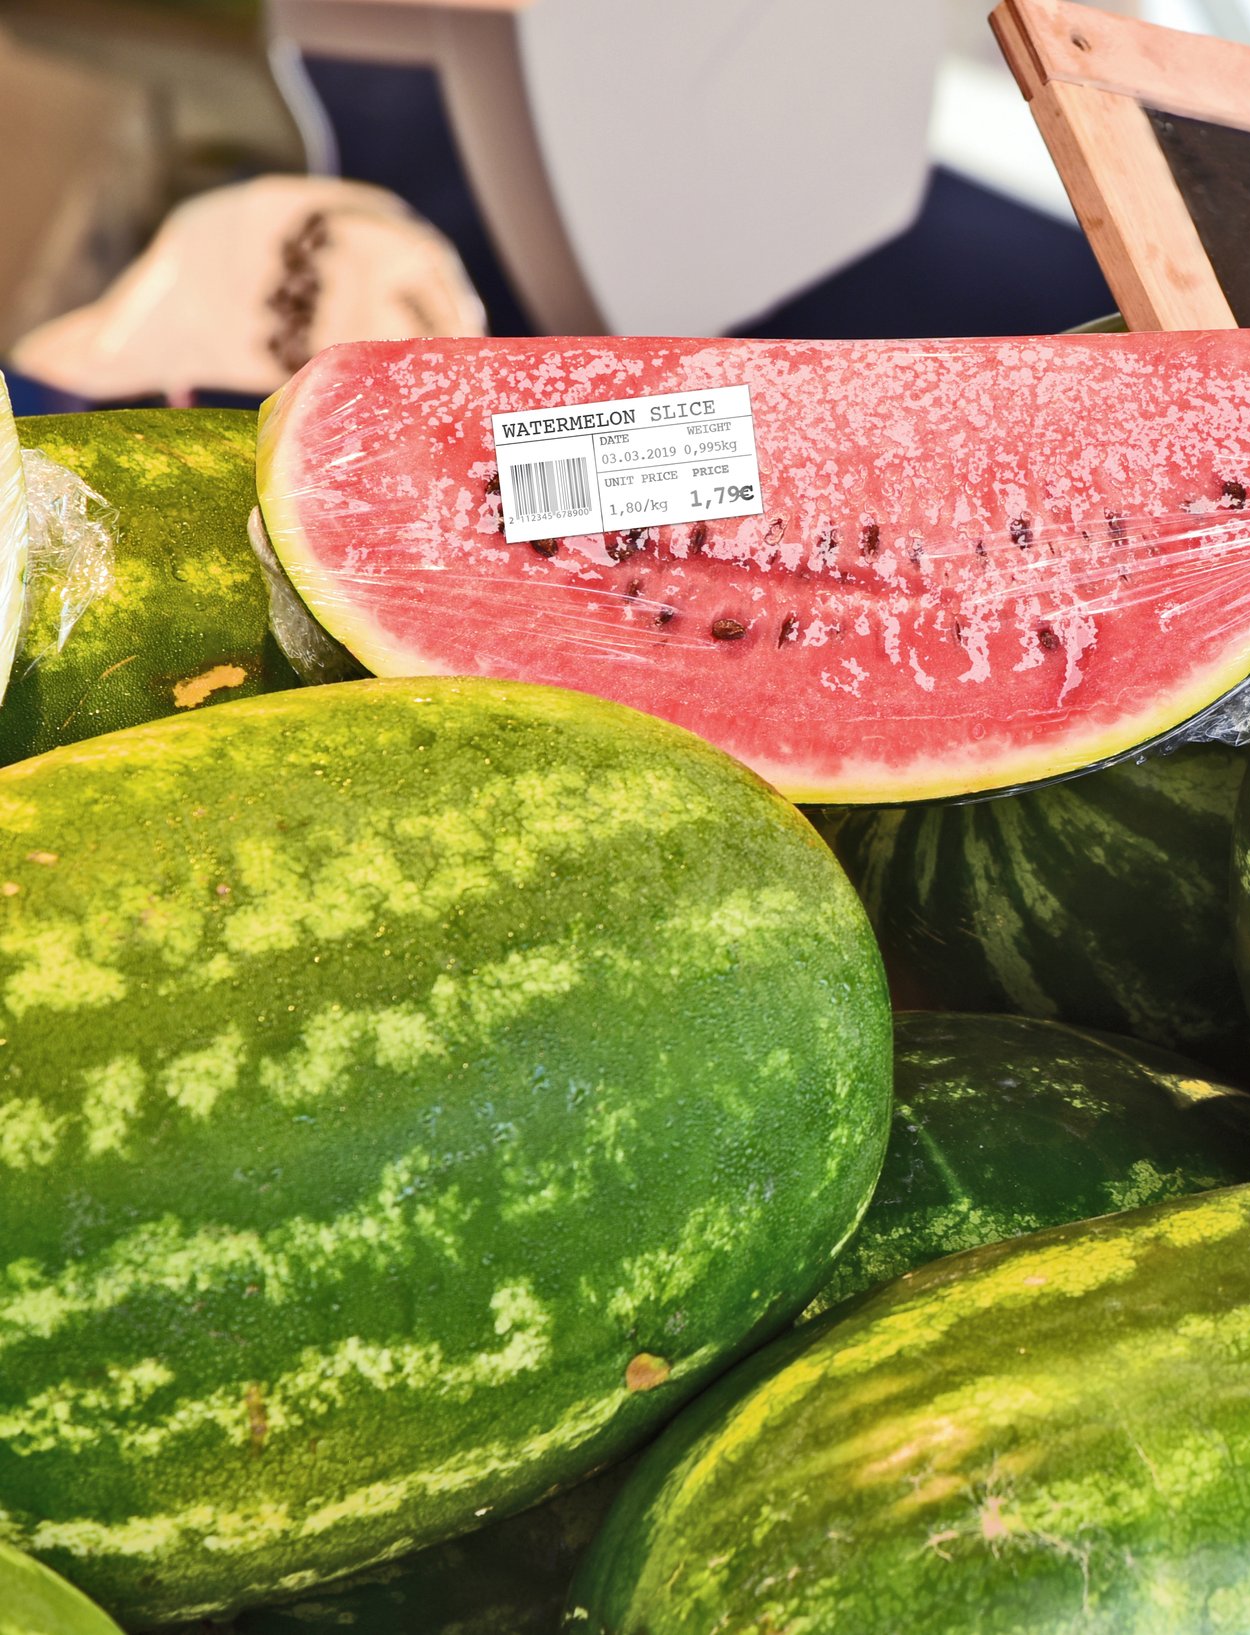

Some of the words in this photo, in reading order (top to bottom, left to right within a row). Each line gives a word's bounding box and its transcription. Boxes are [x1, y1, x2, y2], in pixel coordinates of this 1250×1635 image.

[502, 409, 636, 439] WATERMELON
[650, 400, 716, 422] SLICE
[686, 422, 732, 435] WEIGHT
[600, 434, 630, 446] DATE
[684, 440, 737, 456] 0,995kg
[601, 446, 677, 464] 03.03.2019
[604, 475, 634, 487] UNIT
[641, 471, 678, 483] PRICE
[692, 465, 729, 477] PRICE
[690, 485, 755, 509] 1,79€
[520, 512, 553, 523] 112345
[556, 508, 589, 519] 678900
[609, 499, 668, 516] 1,80/kg
